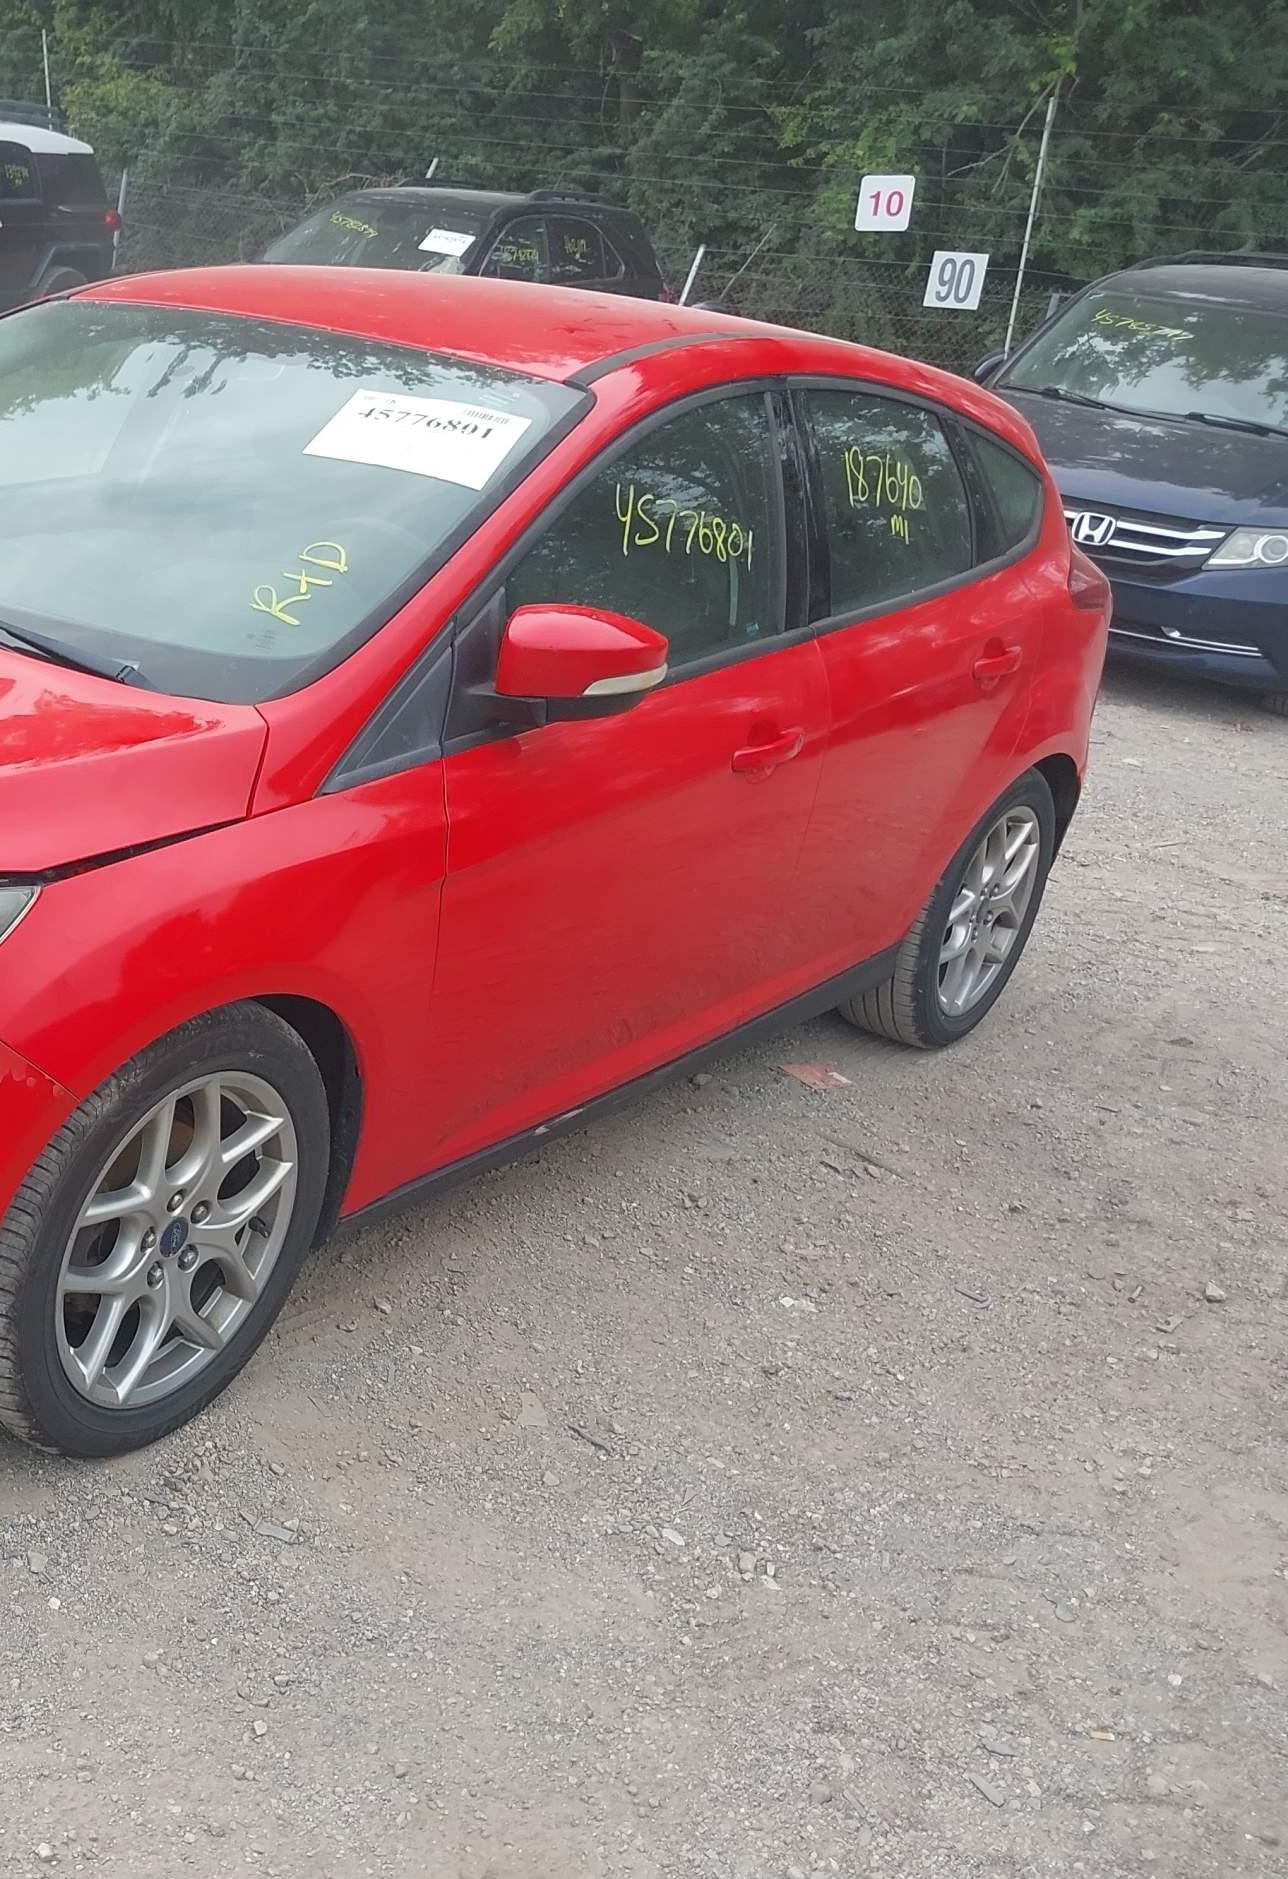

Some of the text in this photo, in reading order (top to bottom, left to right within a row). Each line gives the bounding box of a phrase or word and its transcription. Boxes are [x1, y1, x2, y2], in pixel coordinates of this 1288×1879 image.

[869, 190, 904, 217] 10
[935, 257, 976, 304] 90
[358, 406, 494, 440] 45776801
[844, 446, 923, 511] 187640
[615, 482, 754, 574] 45776801
